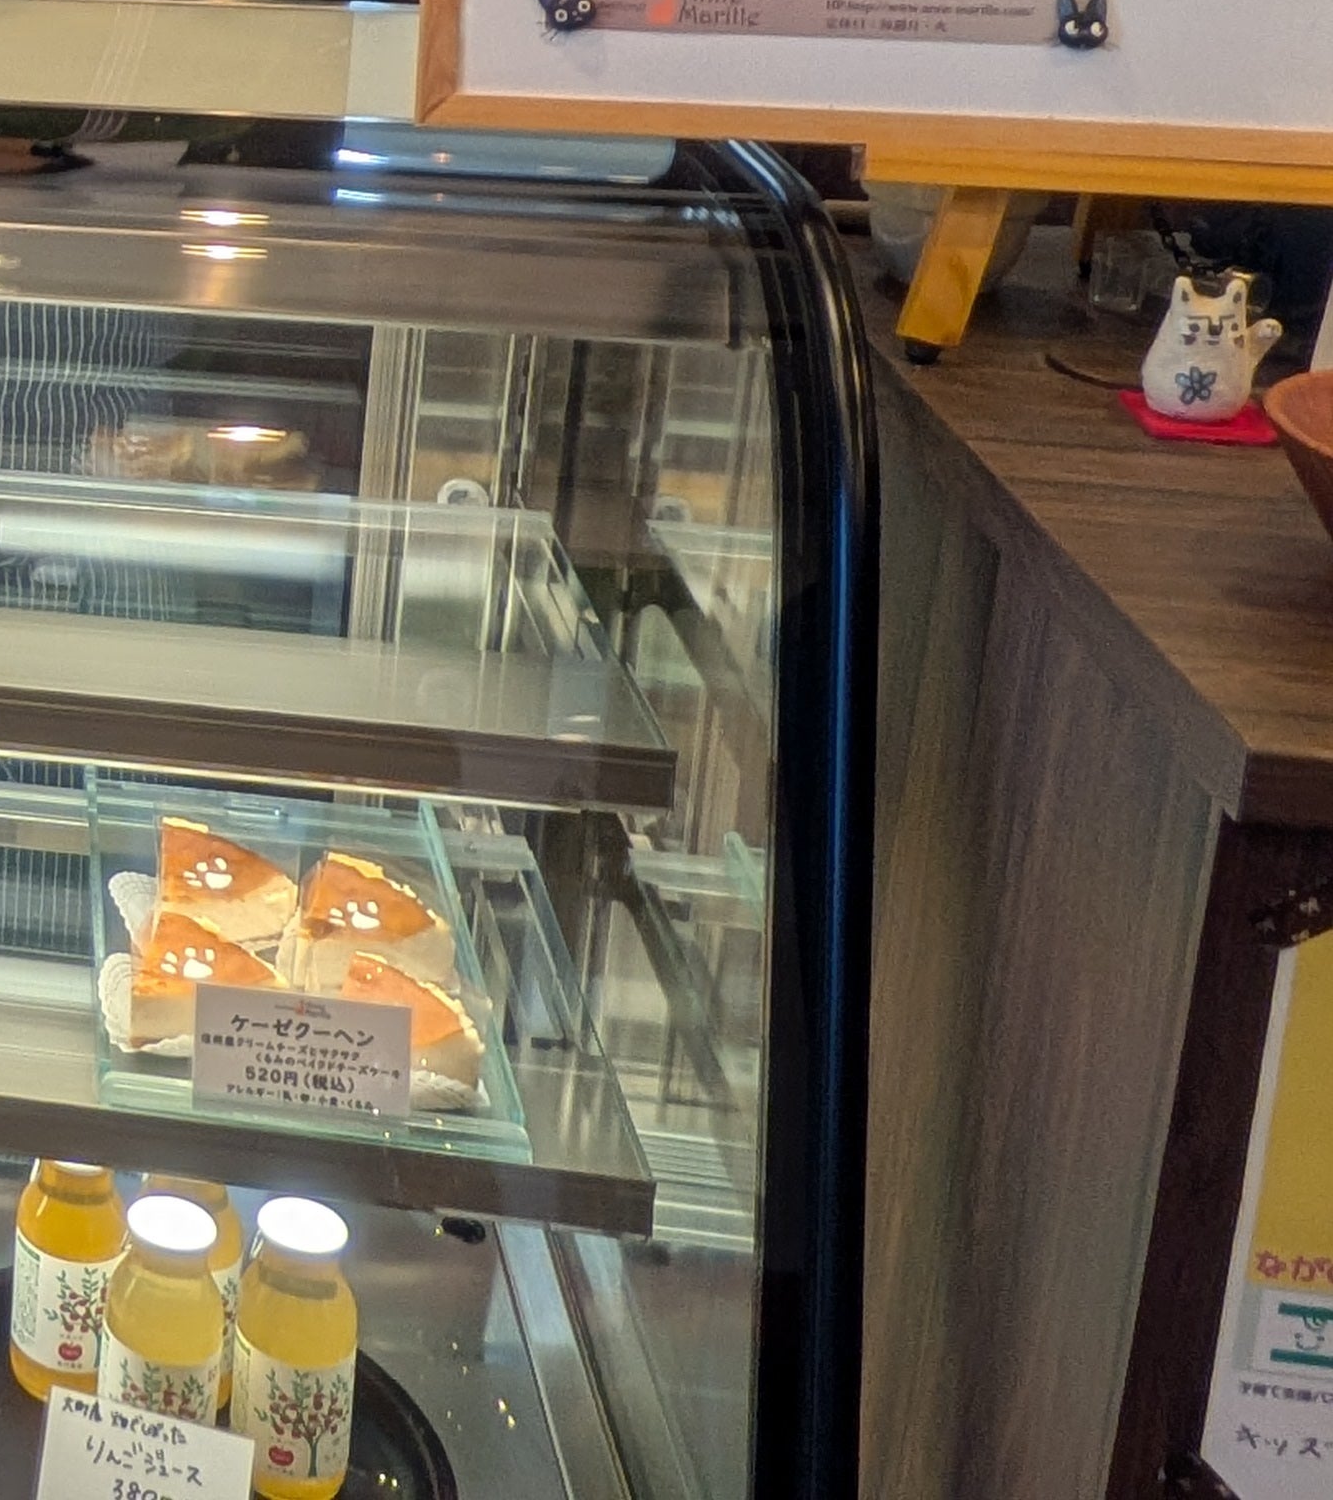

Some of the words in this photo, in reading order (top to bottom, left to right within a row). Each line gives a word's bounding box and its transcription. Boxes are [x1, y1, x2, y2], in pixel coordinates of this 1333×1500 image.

[231, 1013, 375, 1047] ケーゼクーヘン
[1255, 1250, 1333, 1285] なが
